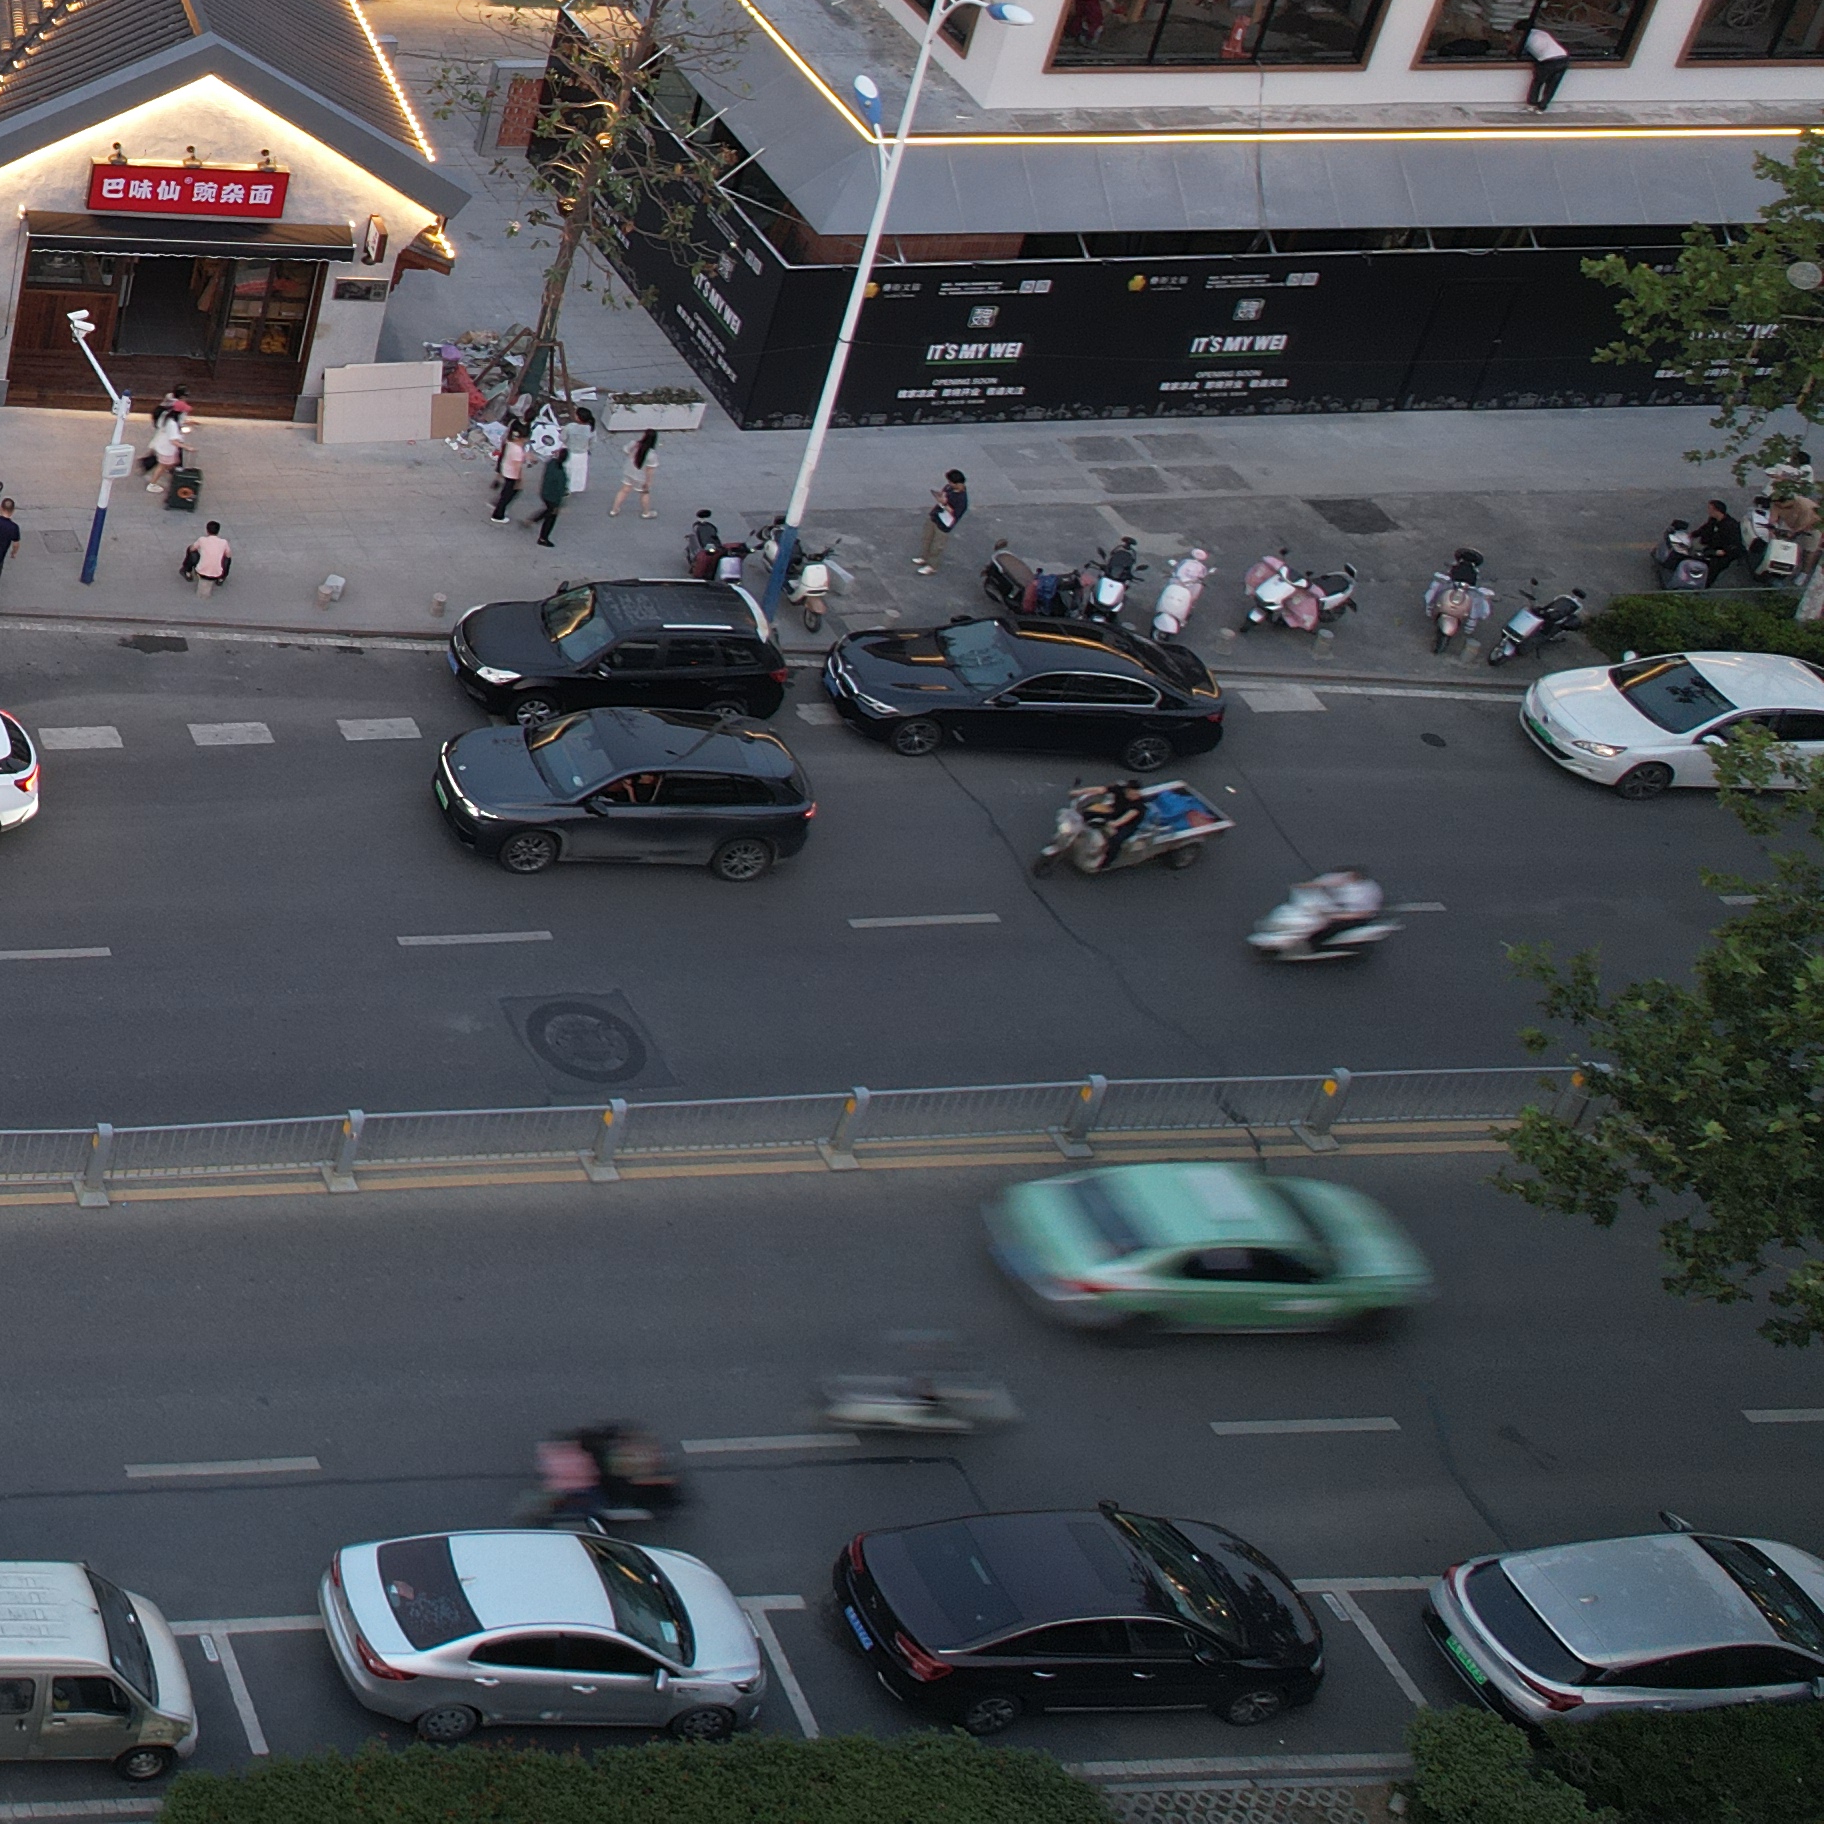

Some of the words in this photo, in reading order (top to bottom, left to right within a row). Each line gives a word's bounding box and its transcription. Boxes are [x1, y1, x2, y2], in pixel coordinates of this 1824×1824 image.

[926, 342, 958, 361] IT'S
[958, 343, 990, 360] MY
[990, 341, 1025, 359] WEI
[1190, 334, 1223, 353] IT'S
[1222, 335, 1254, 352] MY
[1254, 334, 1289, 351] WEI
